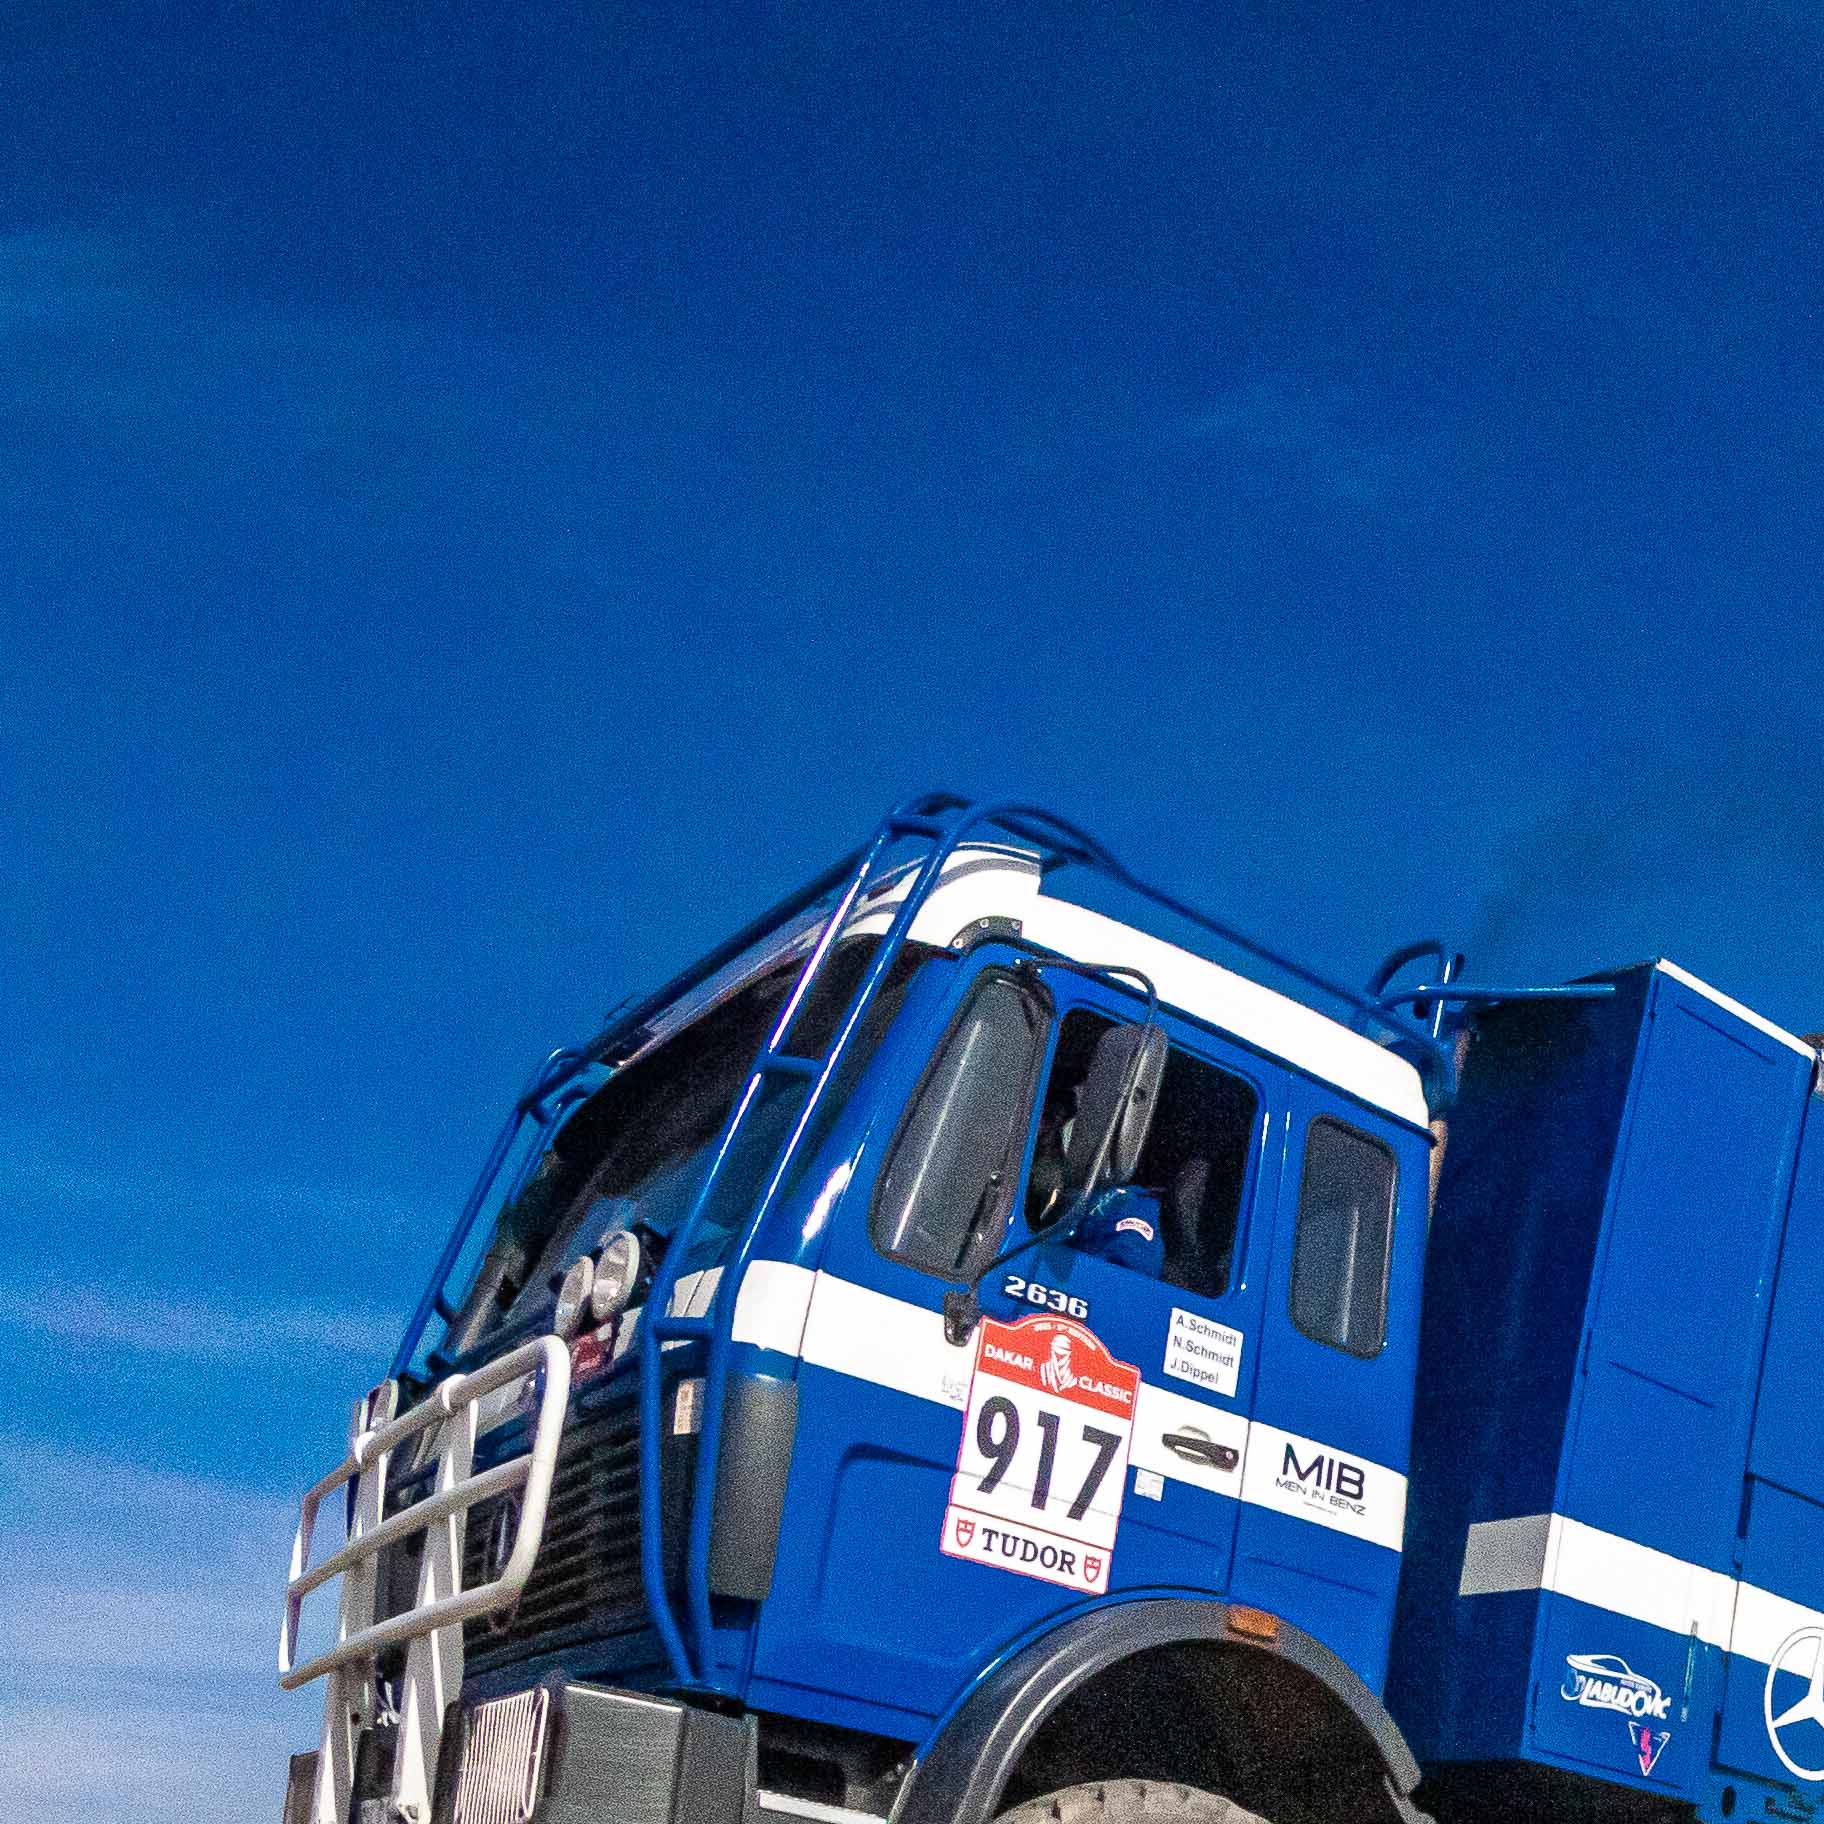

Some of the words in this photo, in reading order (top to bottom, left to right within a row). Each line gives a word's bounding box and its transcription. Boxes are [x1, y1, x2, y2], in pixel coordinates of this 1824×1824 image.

[1005, 1276, 1088, 1318] 2636
[985, 1344, 1034, 1370] DAKAR
[1079, 1376, 1132, 1404] CLASSIC
[977, 1396, 1122, 1521] 917
[1282, 1442, 1365, 1500] MIB
[1275, 1477, 1307, 1495] MEN
[1311, 1489, 1325, 1501] IN
[1329, 1495, 1367, 1516] BENZ
[982, 1528, 1076, 1575] TUDOR
